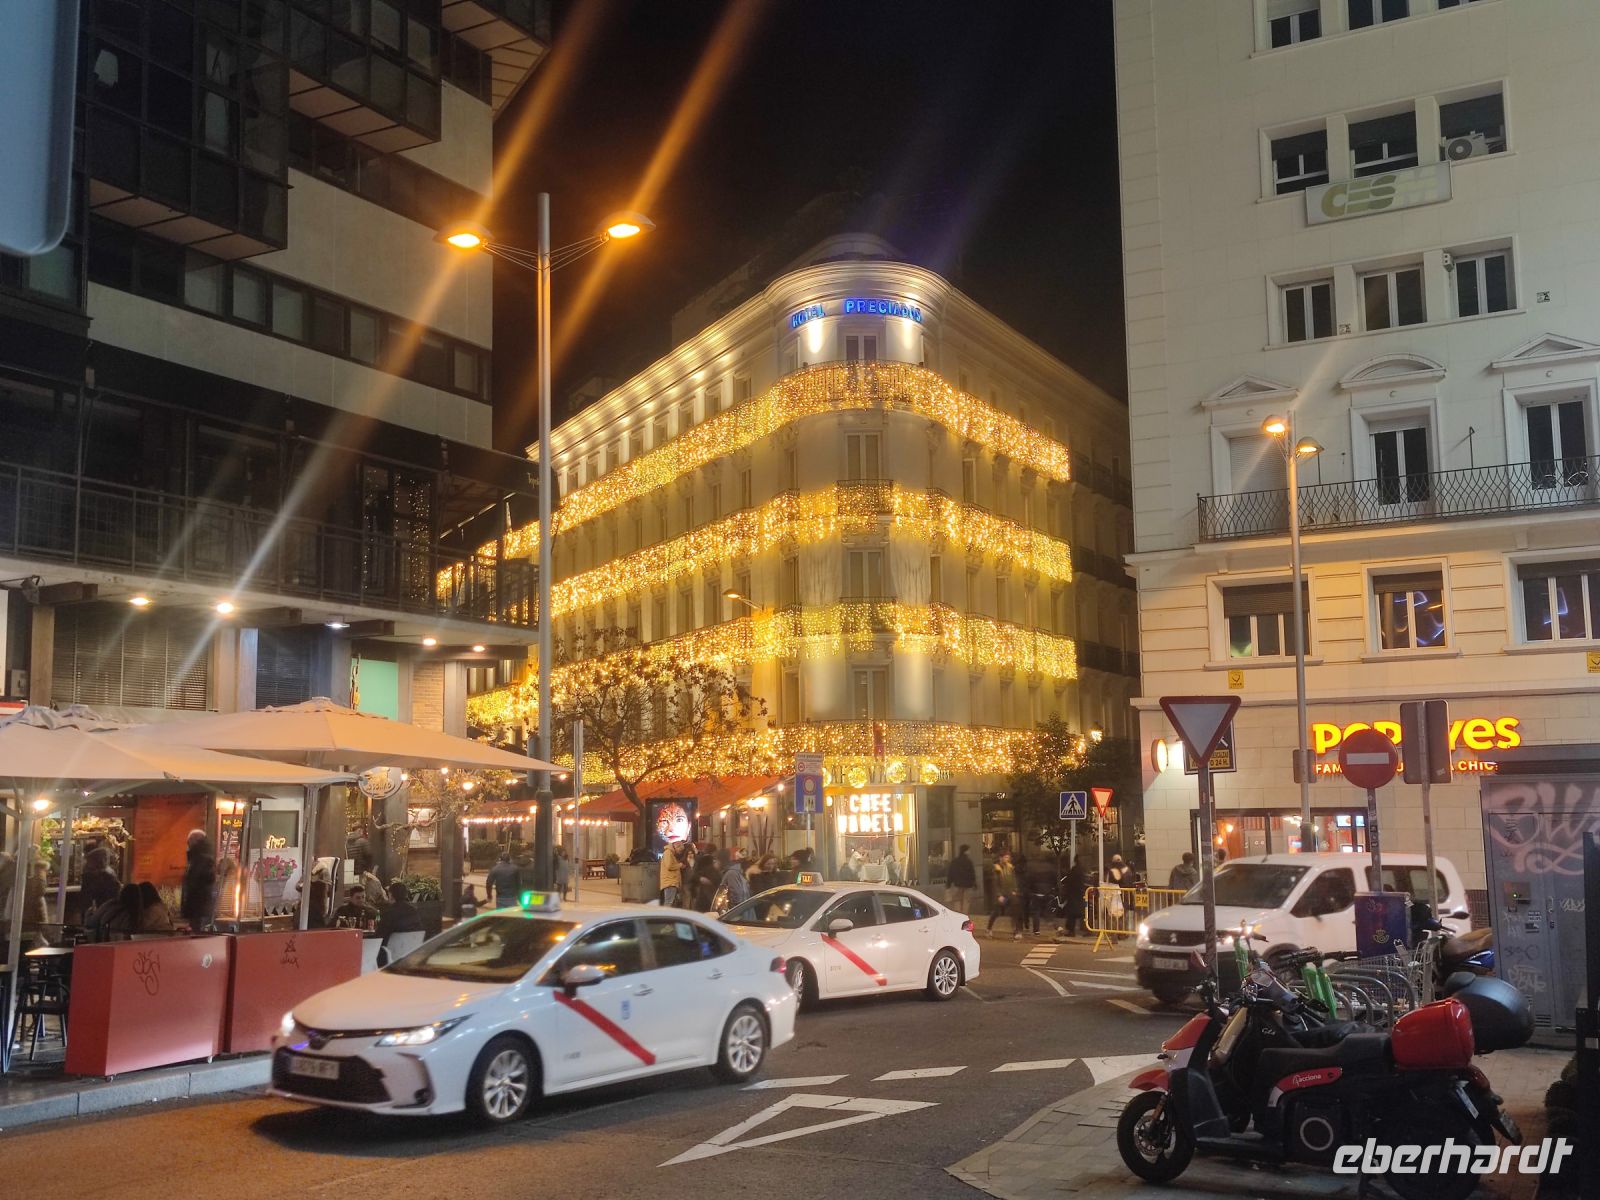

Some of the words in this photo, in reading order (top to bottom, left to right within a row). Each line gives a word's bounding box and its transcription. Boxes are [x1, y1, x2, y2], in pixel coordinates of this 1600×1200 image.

[792, 304, 825, 328] HOTEL
[845, 299, 922, 322] PRECIADOS
[1299, 1074, 1321, 1083] acciona
